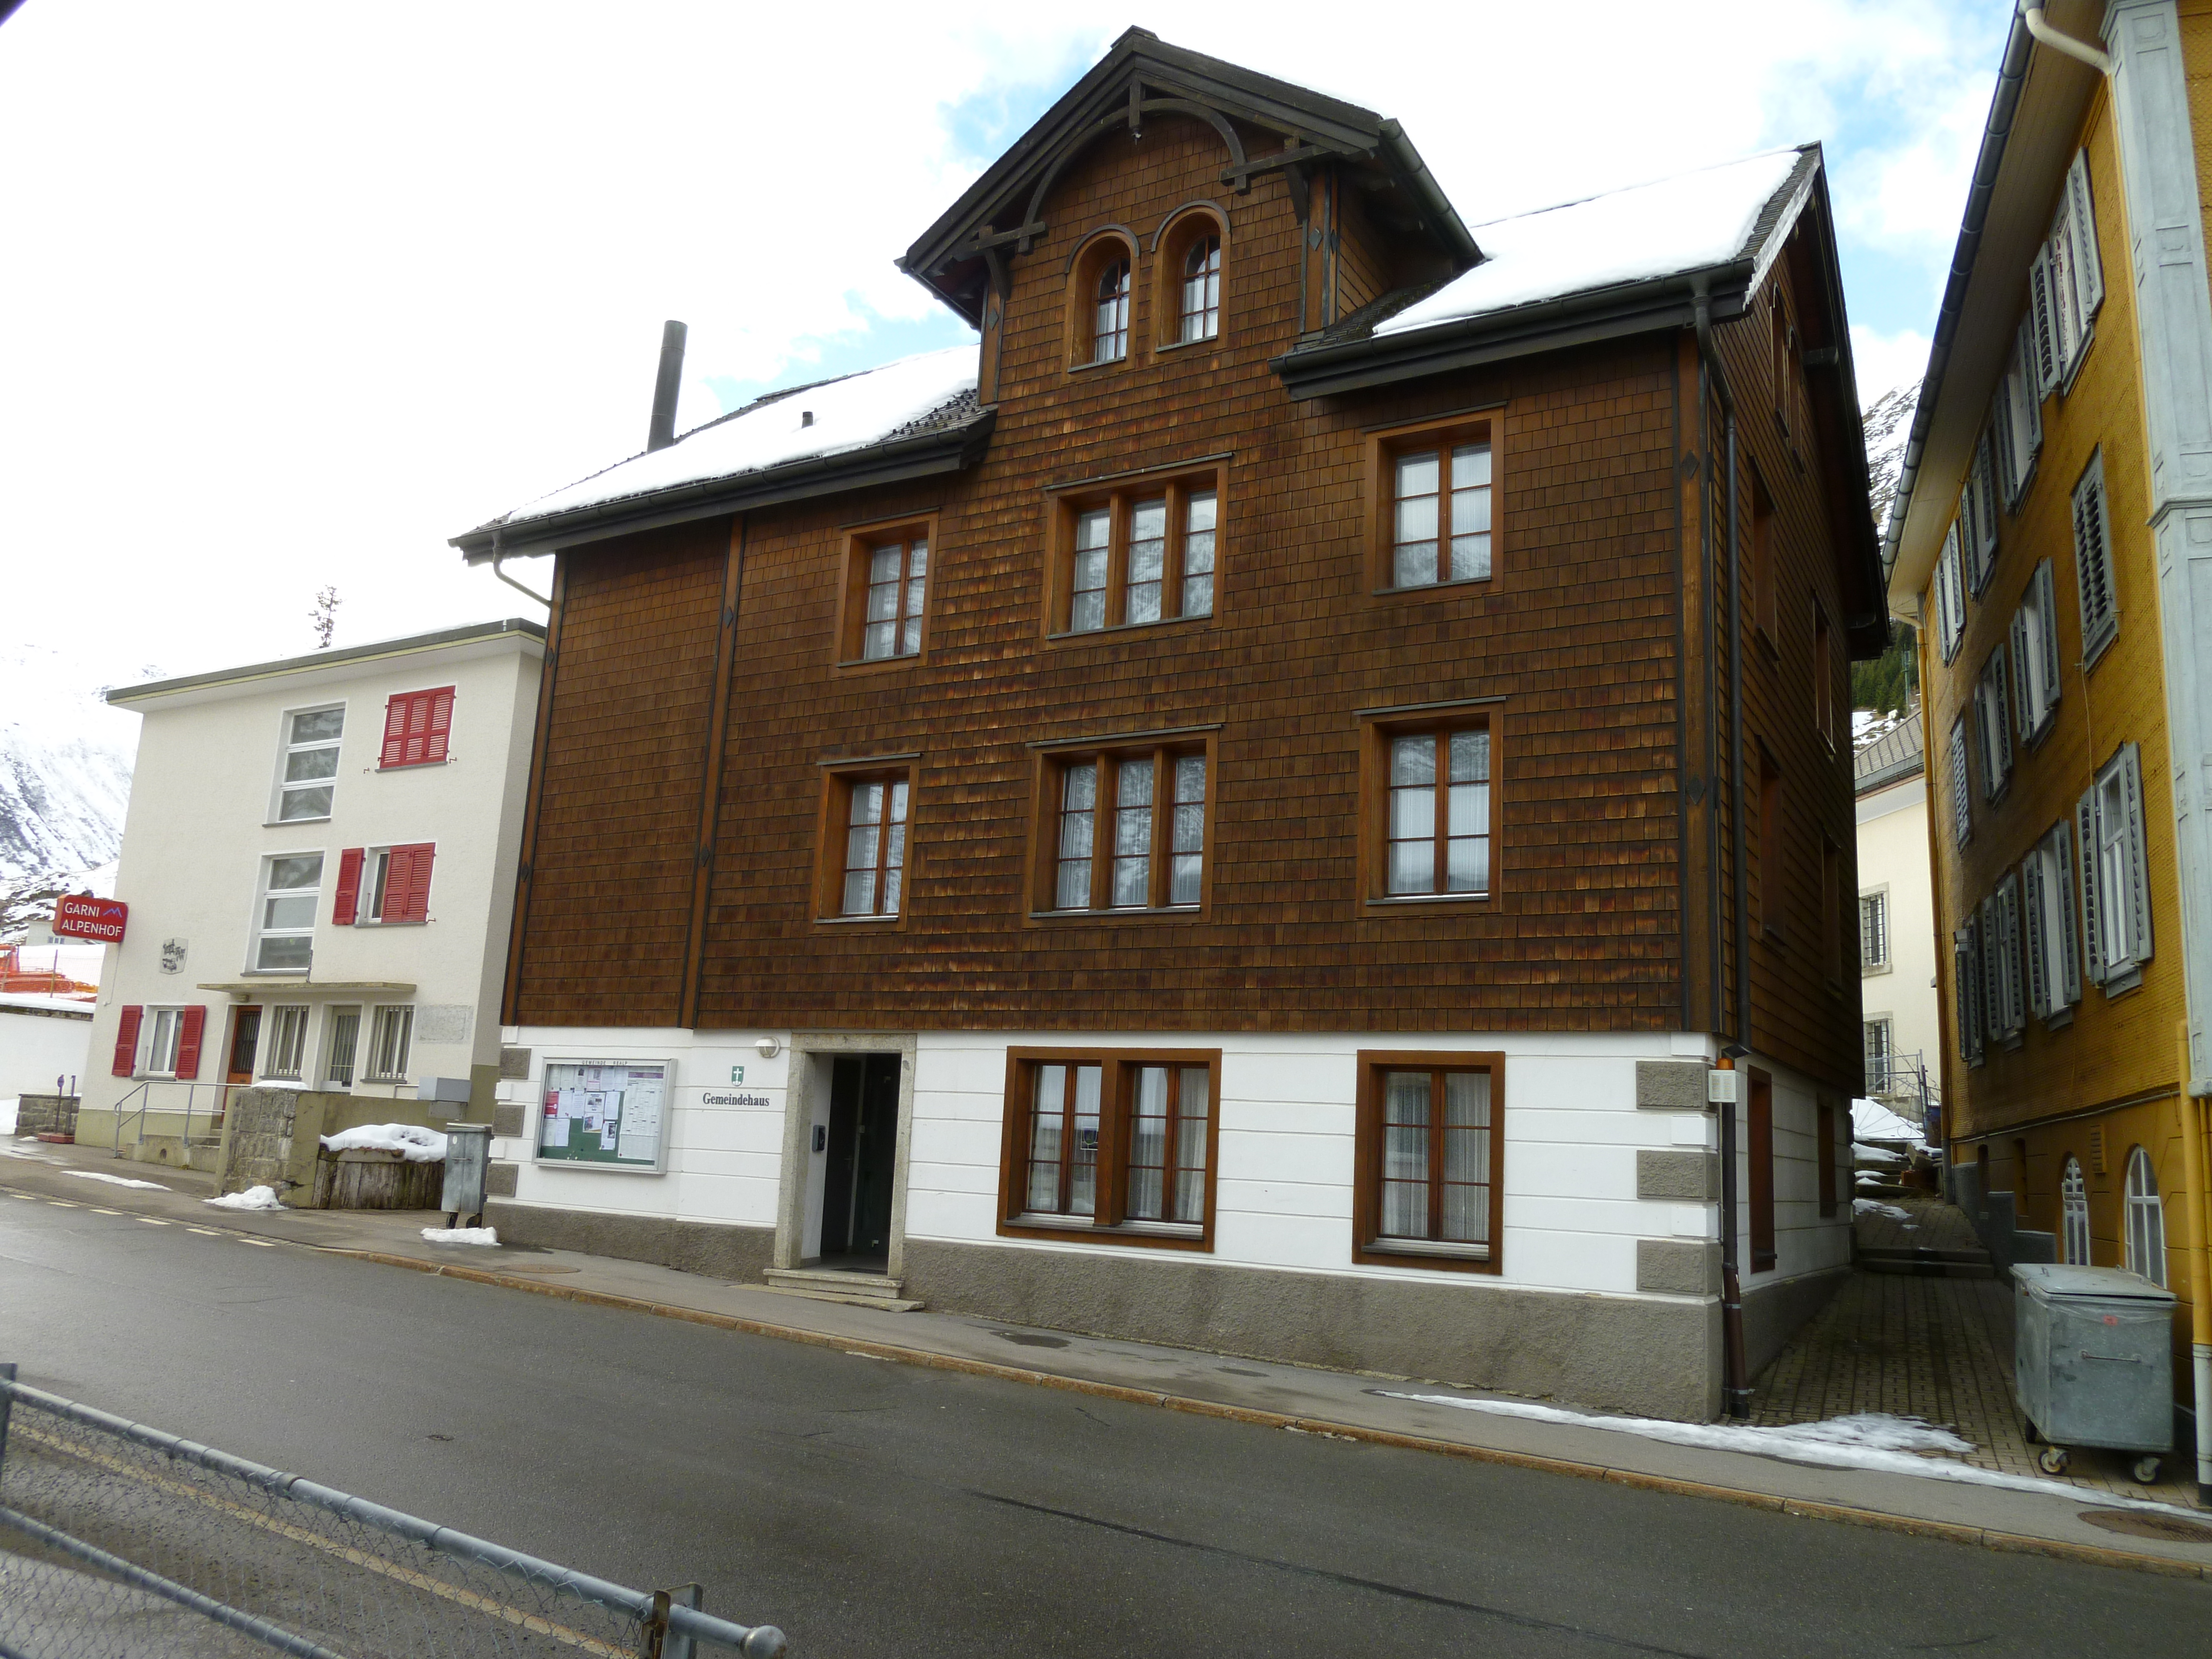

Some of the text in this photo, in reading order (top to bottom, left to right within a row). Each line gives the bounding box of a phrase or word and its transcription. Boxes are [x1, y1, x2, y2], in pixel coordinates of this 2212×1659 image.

[65, 902, 100, 917] GARNI
[61, 920, 123, 937] ALPENHOF
[703, 1092, 770, 1107] Gemeindehaus
